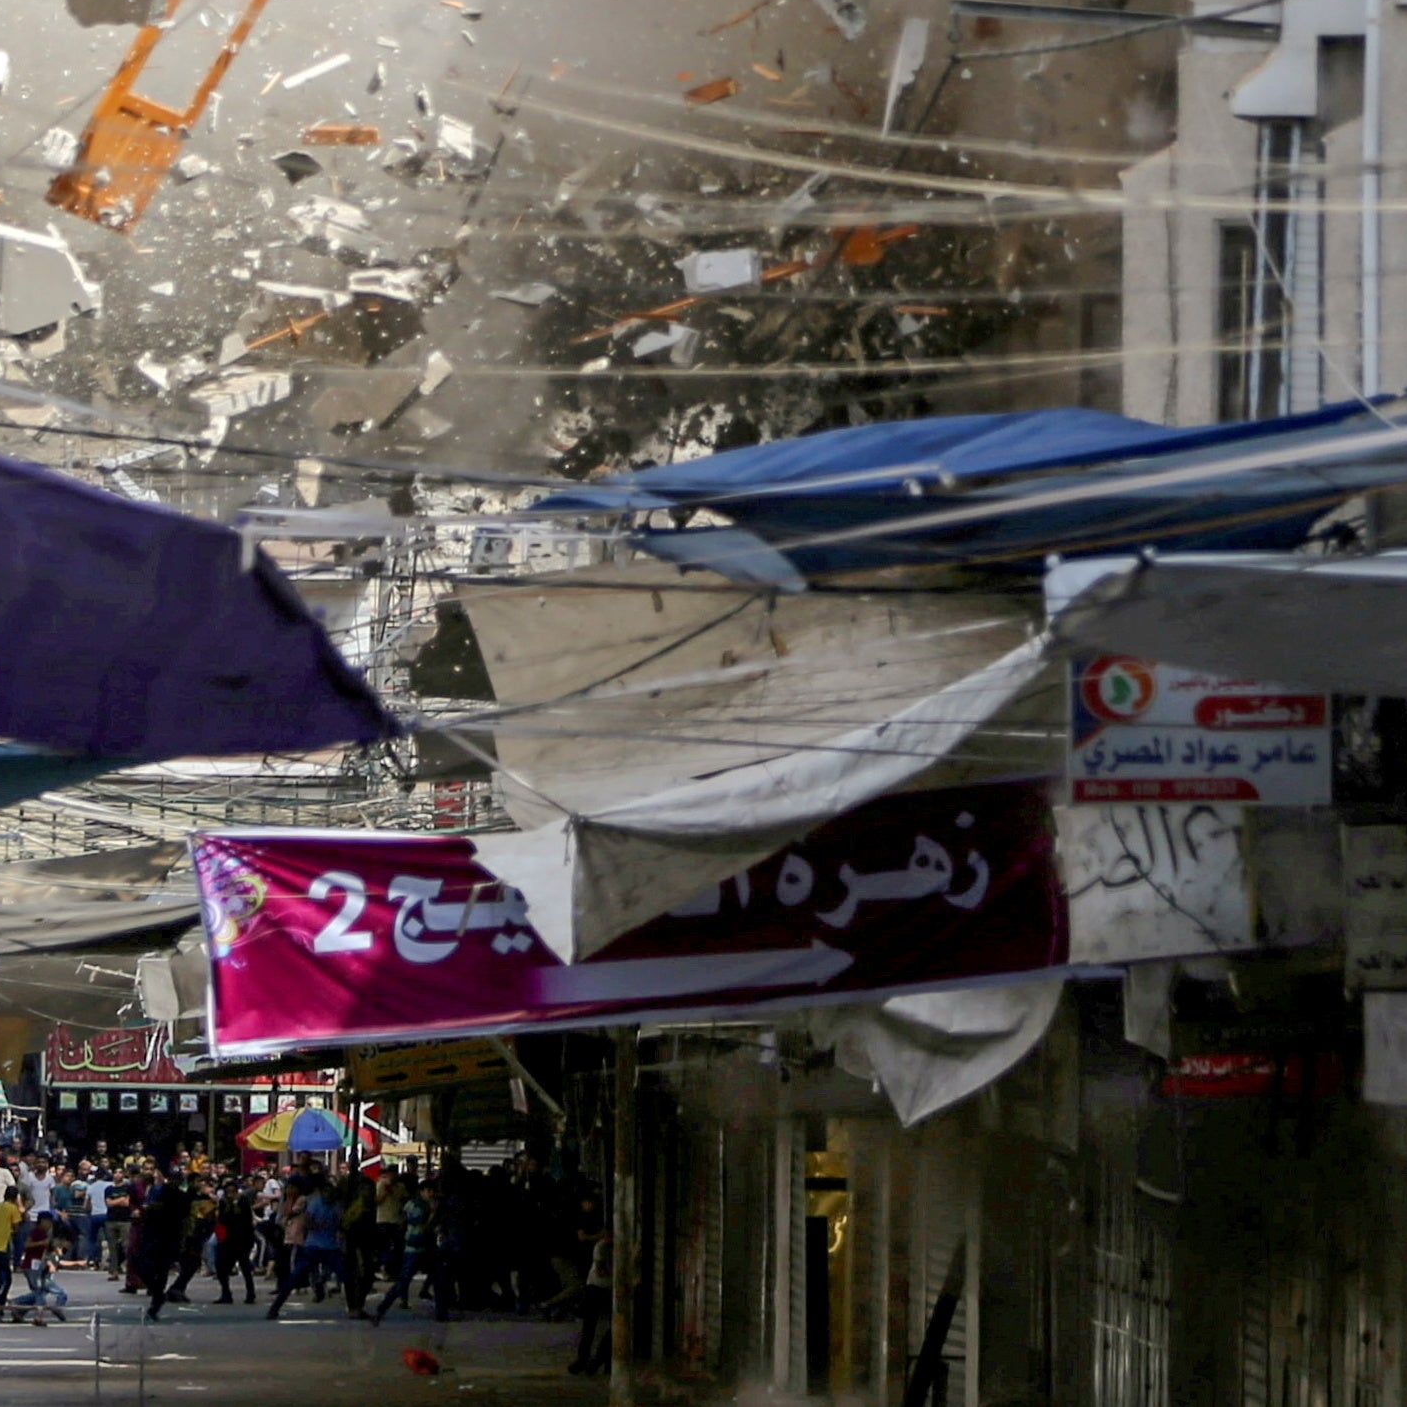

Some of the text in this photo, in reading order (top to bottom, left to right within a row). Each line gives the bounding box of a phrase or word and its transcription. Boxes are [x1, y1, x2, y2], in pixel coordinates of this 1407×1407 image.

[1083, 735, 1317, 775] عامر عواد المصري
[307, 869, 373, 954] 2
[776, 810, 991, 929] زهره
